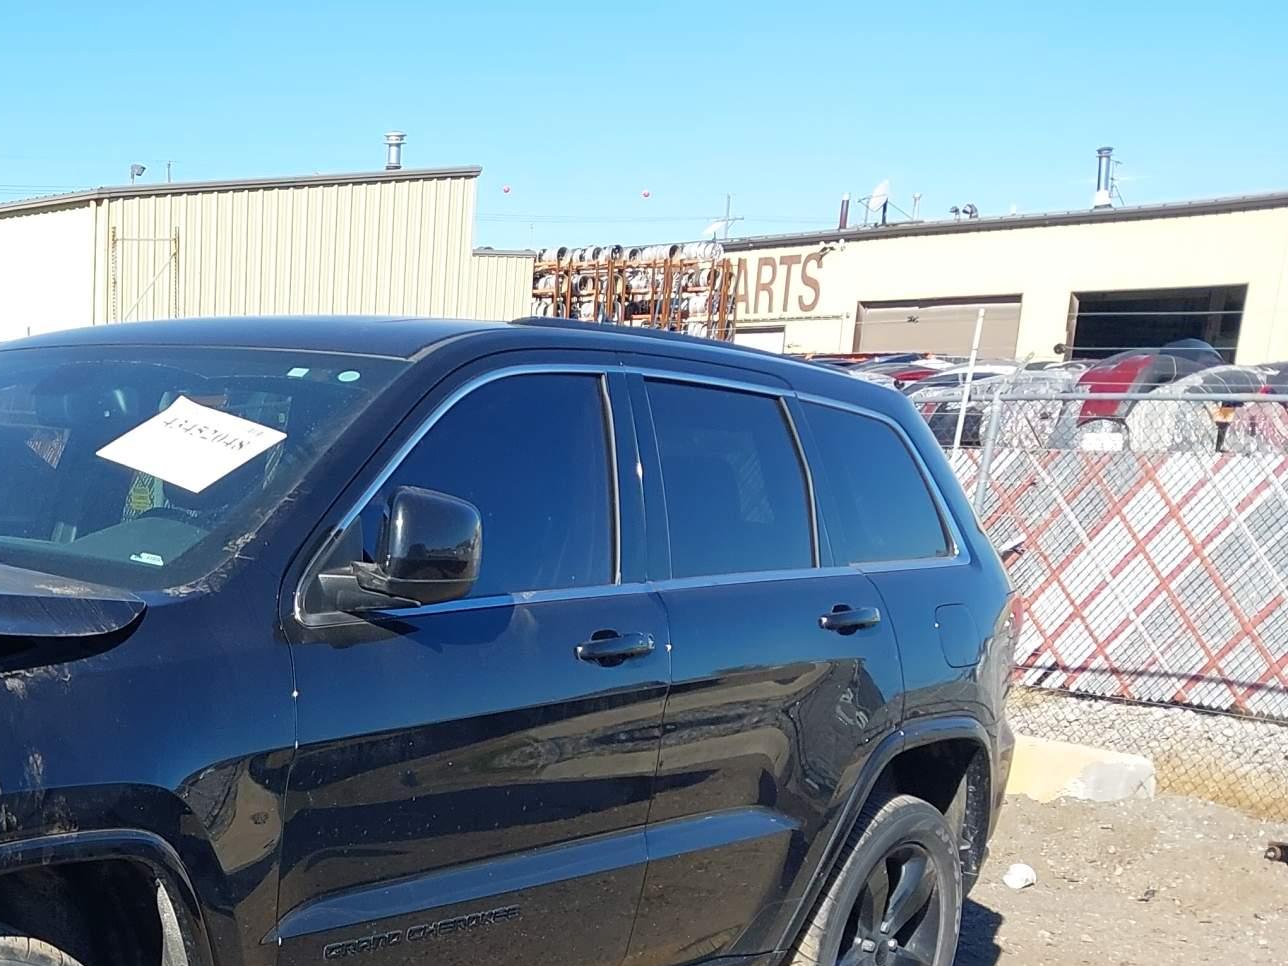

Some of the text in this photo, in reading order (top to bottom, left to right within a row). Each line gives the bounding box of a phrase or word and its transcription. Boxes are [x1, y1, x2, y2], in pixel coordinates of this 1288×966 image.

[733, 253, 824, 314] ARTS
[322, 903, 521, 961] GRAND CHEROKEE
